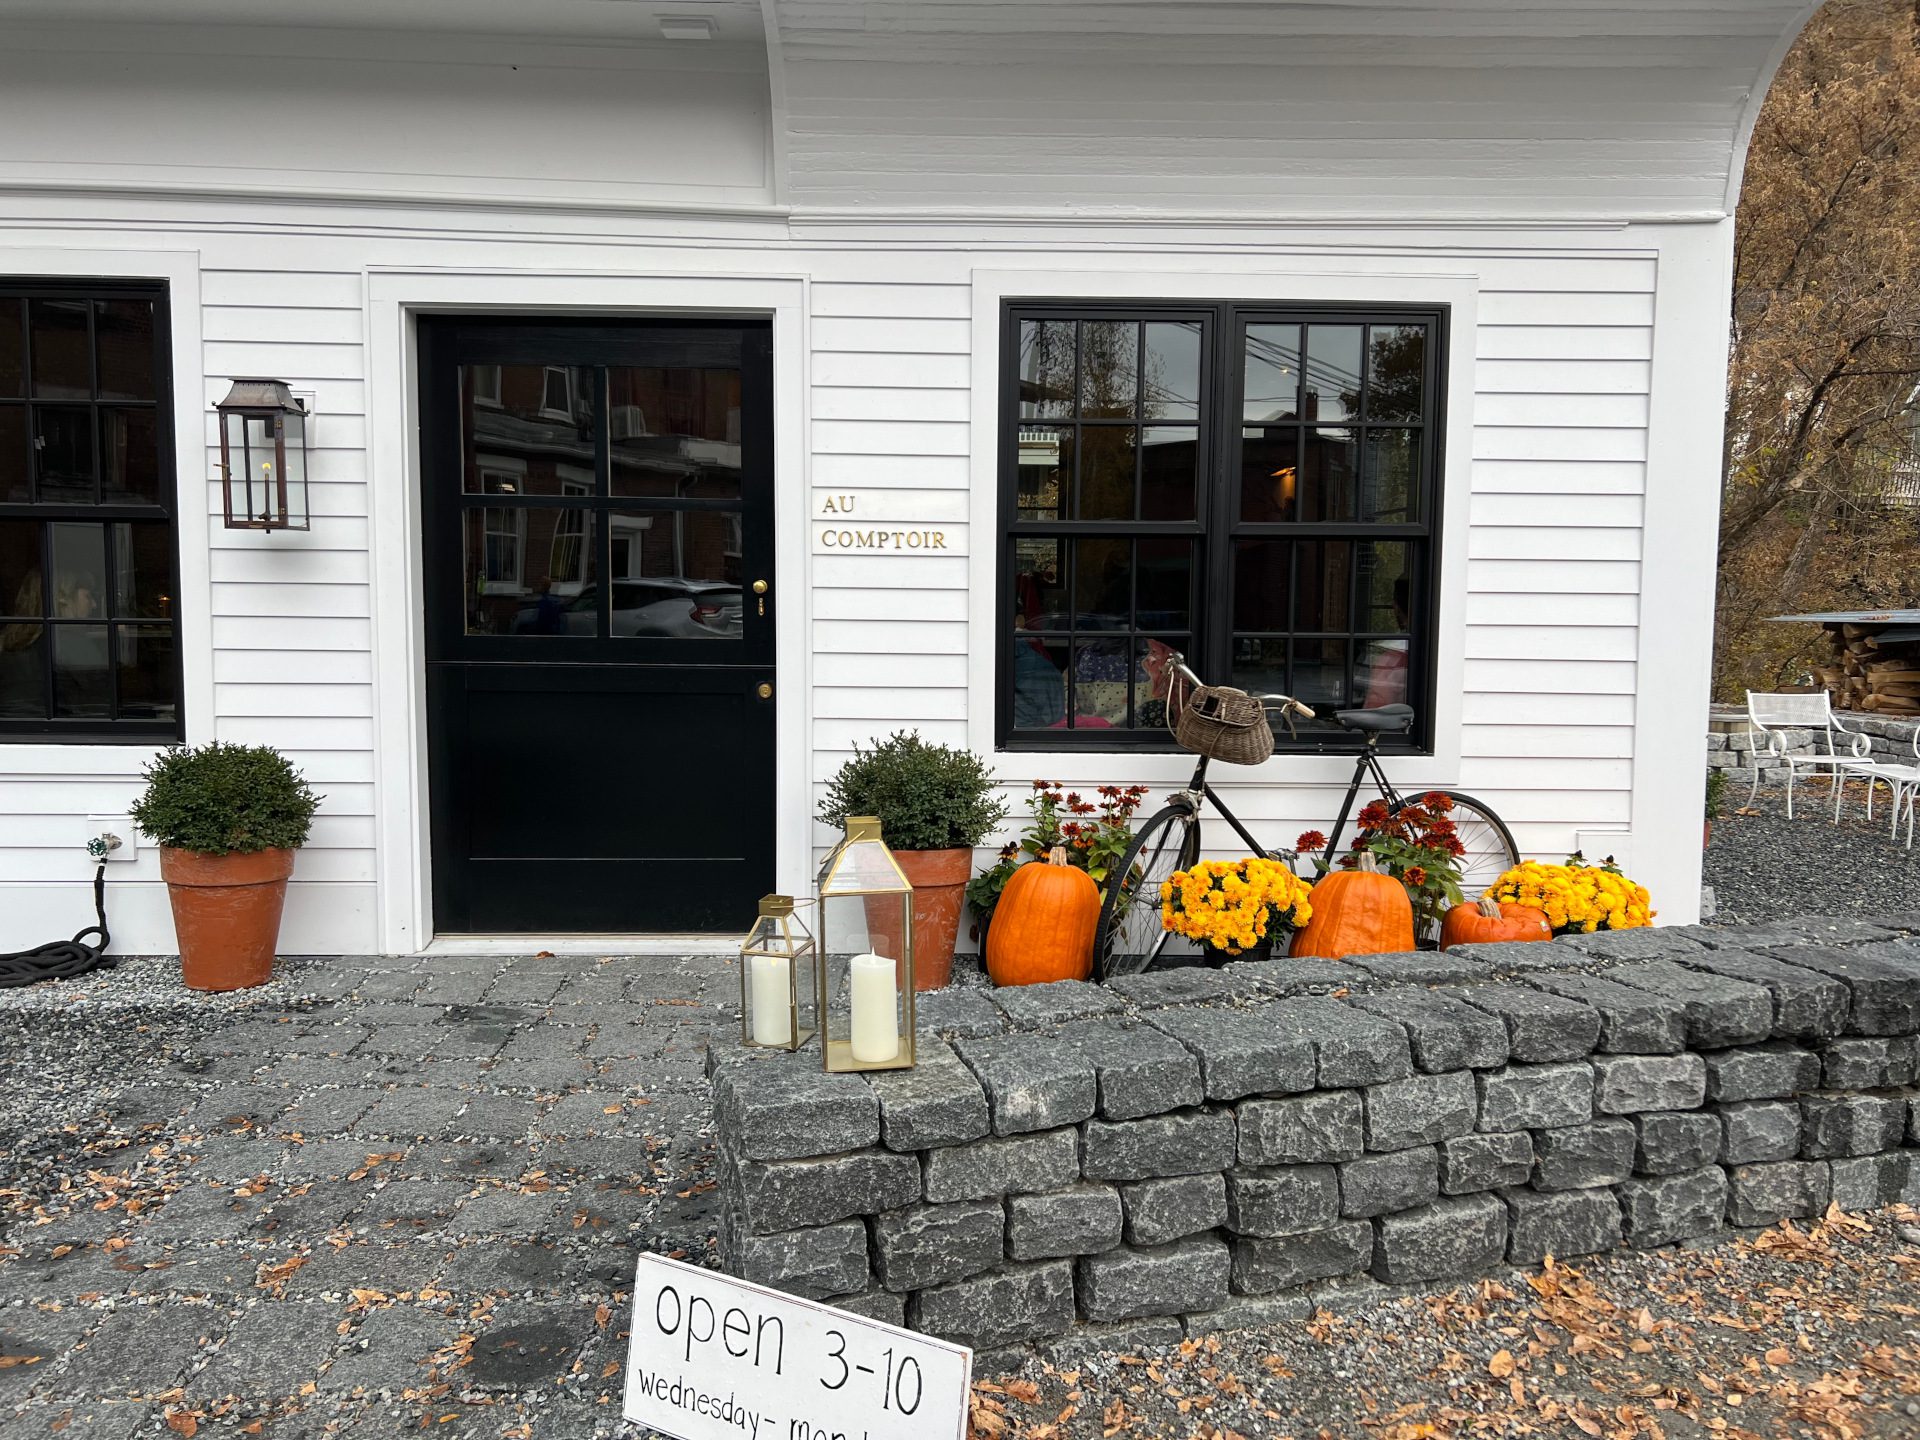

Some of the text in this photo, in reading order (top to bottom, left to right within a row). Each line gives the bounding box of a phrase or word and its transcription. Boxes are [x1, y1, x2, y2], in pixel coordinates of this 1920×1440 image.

[822, 495, 856, 513] AU
[821, 529, 948, 550] COMPTOIR
[655, 1285, 923, 1416] open 3-10
